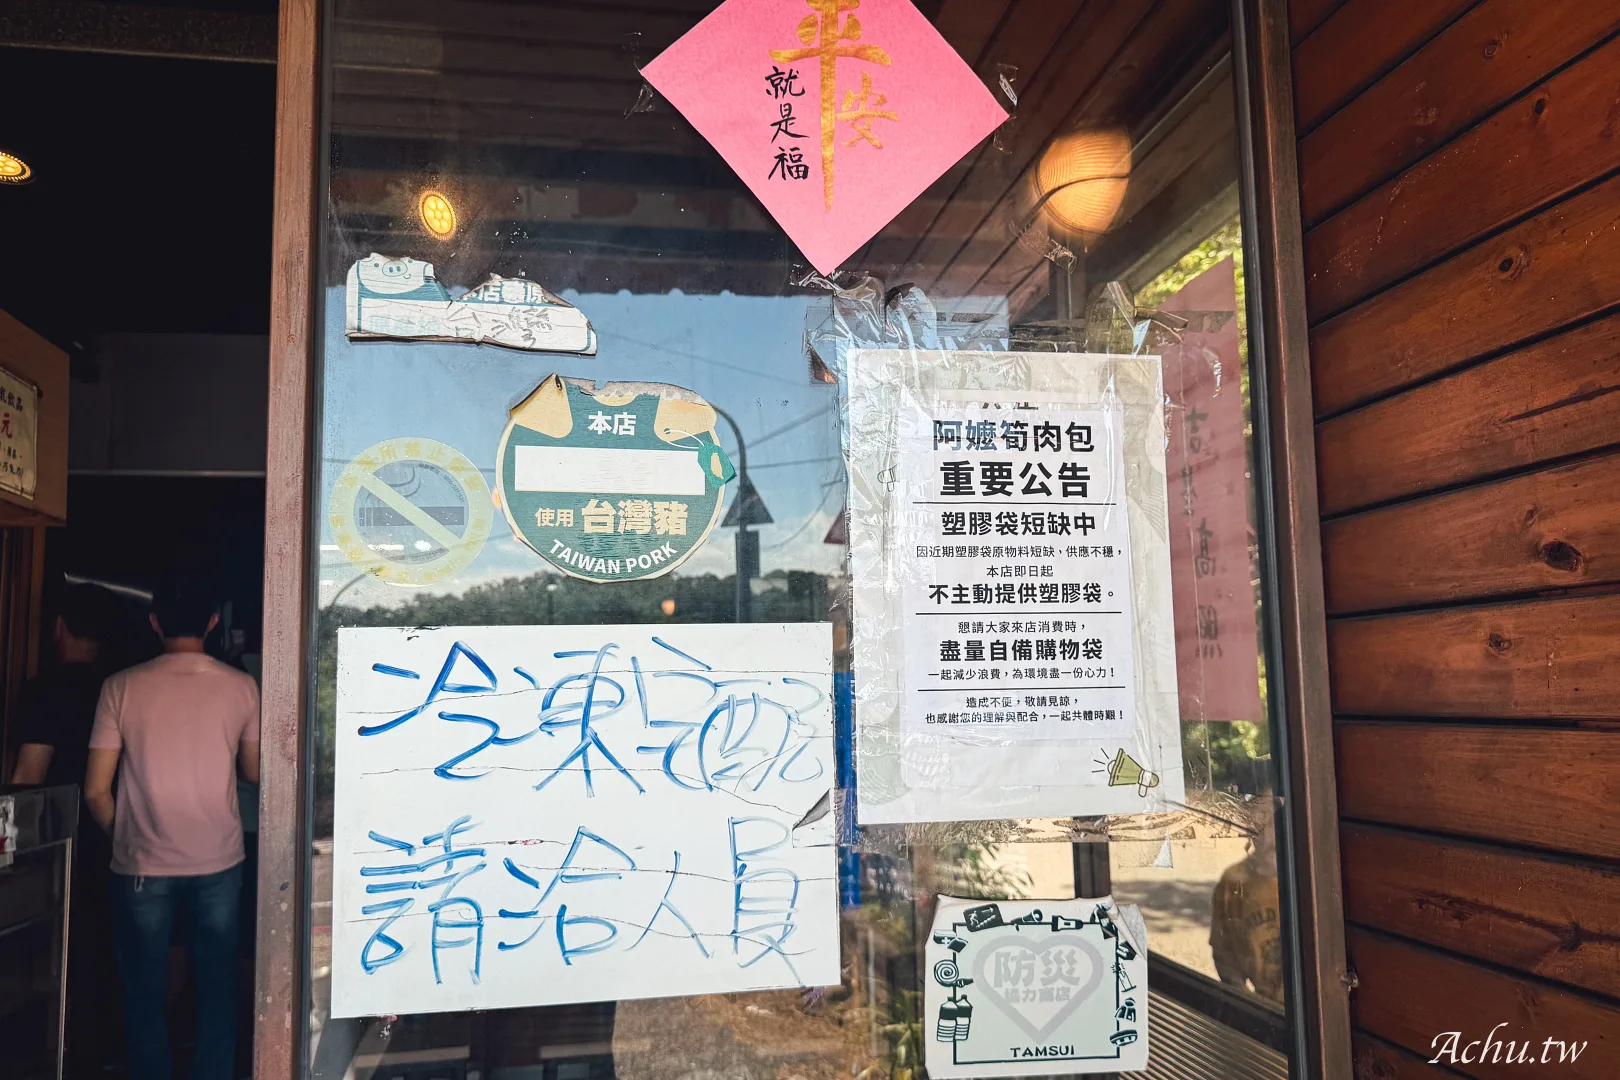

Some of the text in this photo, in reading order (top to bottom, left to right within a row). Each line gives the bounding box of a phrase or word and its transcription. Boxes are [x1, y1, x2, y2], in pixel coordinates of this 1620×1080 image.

[764, 66, 811, 181] 就是福
[588, 410, 636, 437] 本店
[933, 419, 1094, 453] 阿嬤筍肉包
[940, 460, 1091, 498] 重要公告
[535, 498, 688, 536] 使用 台灣豬
[941, 511, 1096, 537] 塑膠袋短缺中
[549, 538, 678, 574] TAIWAN PORK
[986, 565, 1054, 578] 本店即日起
[928, 583, 1115, 605] 不主動提供塑膠袋。
[958, 620, 1086, 634] 懇請大家來店消費時，
[939, 639, 1103, 662] 盡量自備購物袋
[965, 695, 1078, 709] 造成不便，敬請見諒，
[360, 815, 807, 988] 請洽人員
[993, 948, 1080, 988] 防災
[1009, 1044, 1075, 1058] TAMSUI
